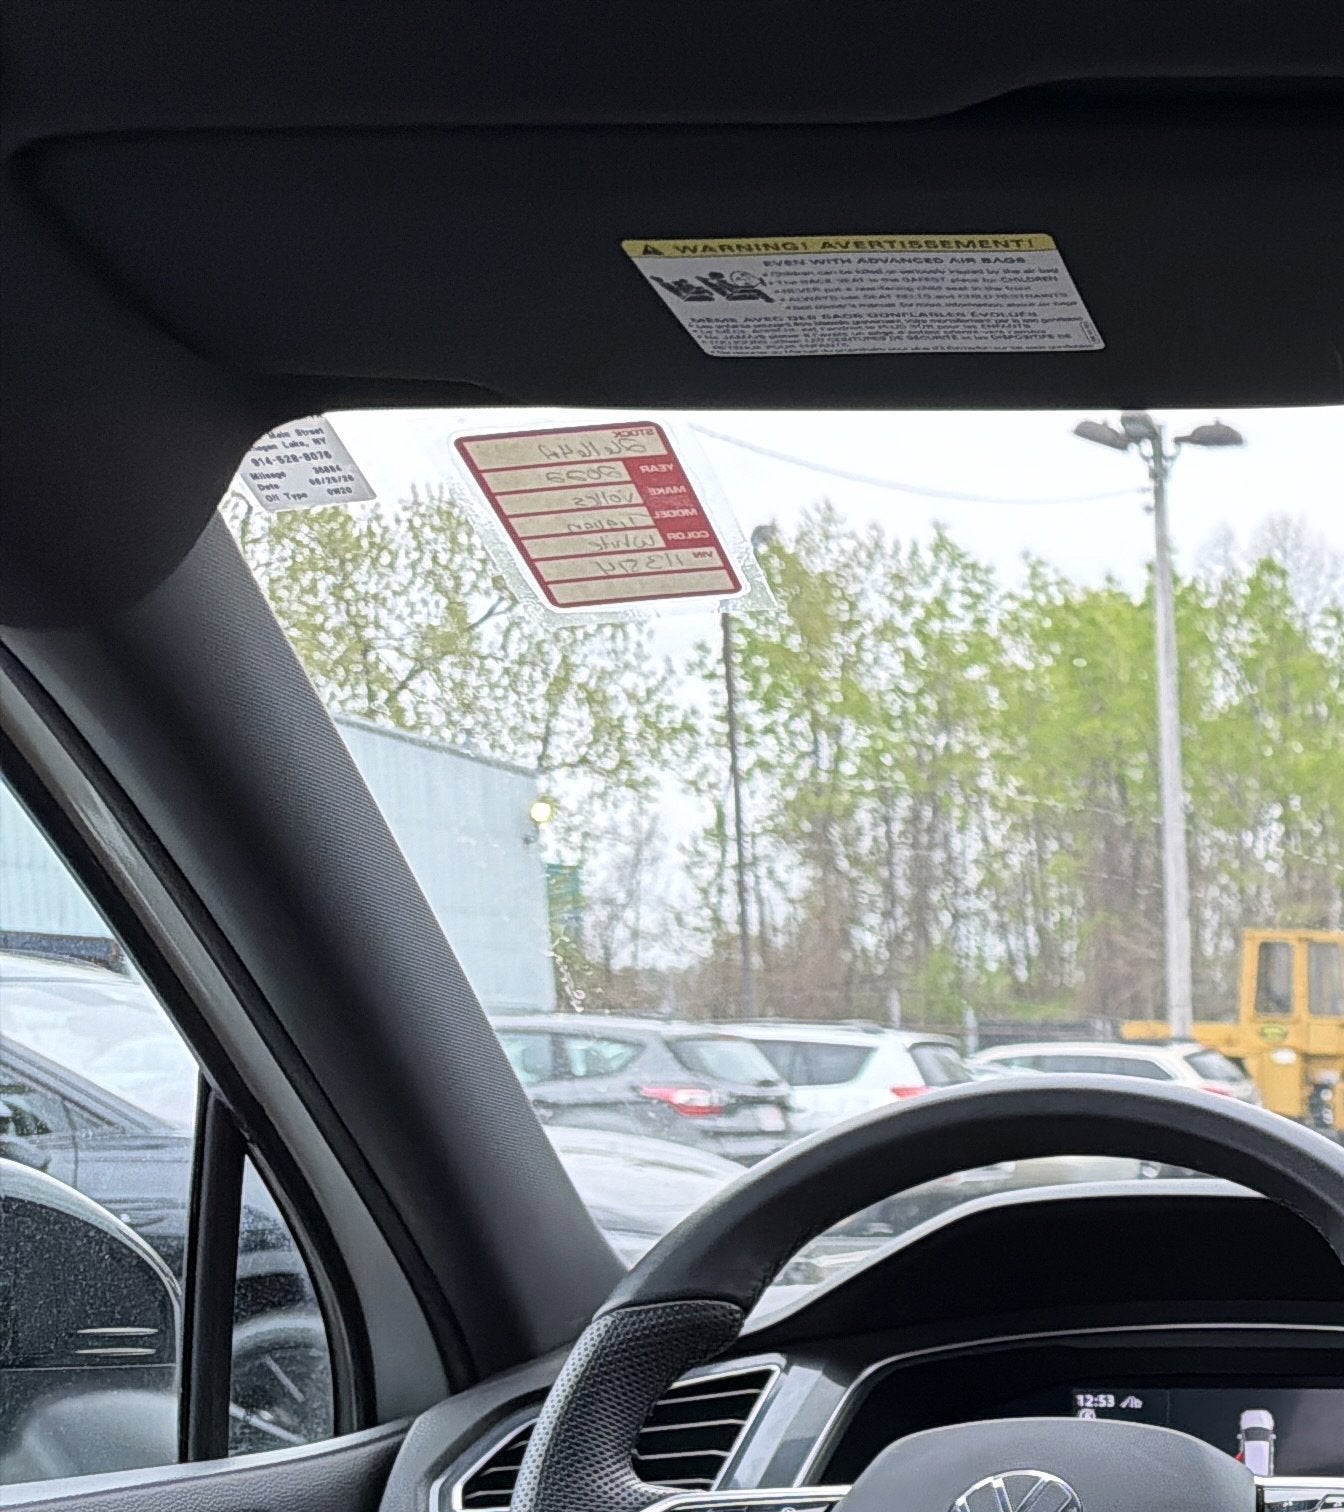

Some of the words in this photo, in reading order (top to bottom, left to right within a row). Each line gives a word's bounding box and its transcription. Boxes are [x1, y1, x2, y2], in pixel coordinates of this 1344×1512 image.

[674, 241, 807, 254] WARNING!
[820, 239, 1033, 251] AVERTISSEMENT!
[249, 471, 286, 481] Mileage
[257, 483, 280, 491] Date
[265, 493, 280, 502] Oil
[283, 491, 308, 501] Type
[1076, 1394, 1115, 1407] 12:53
